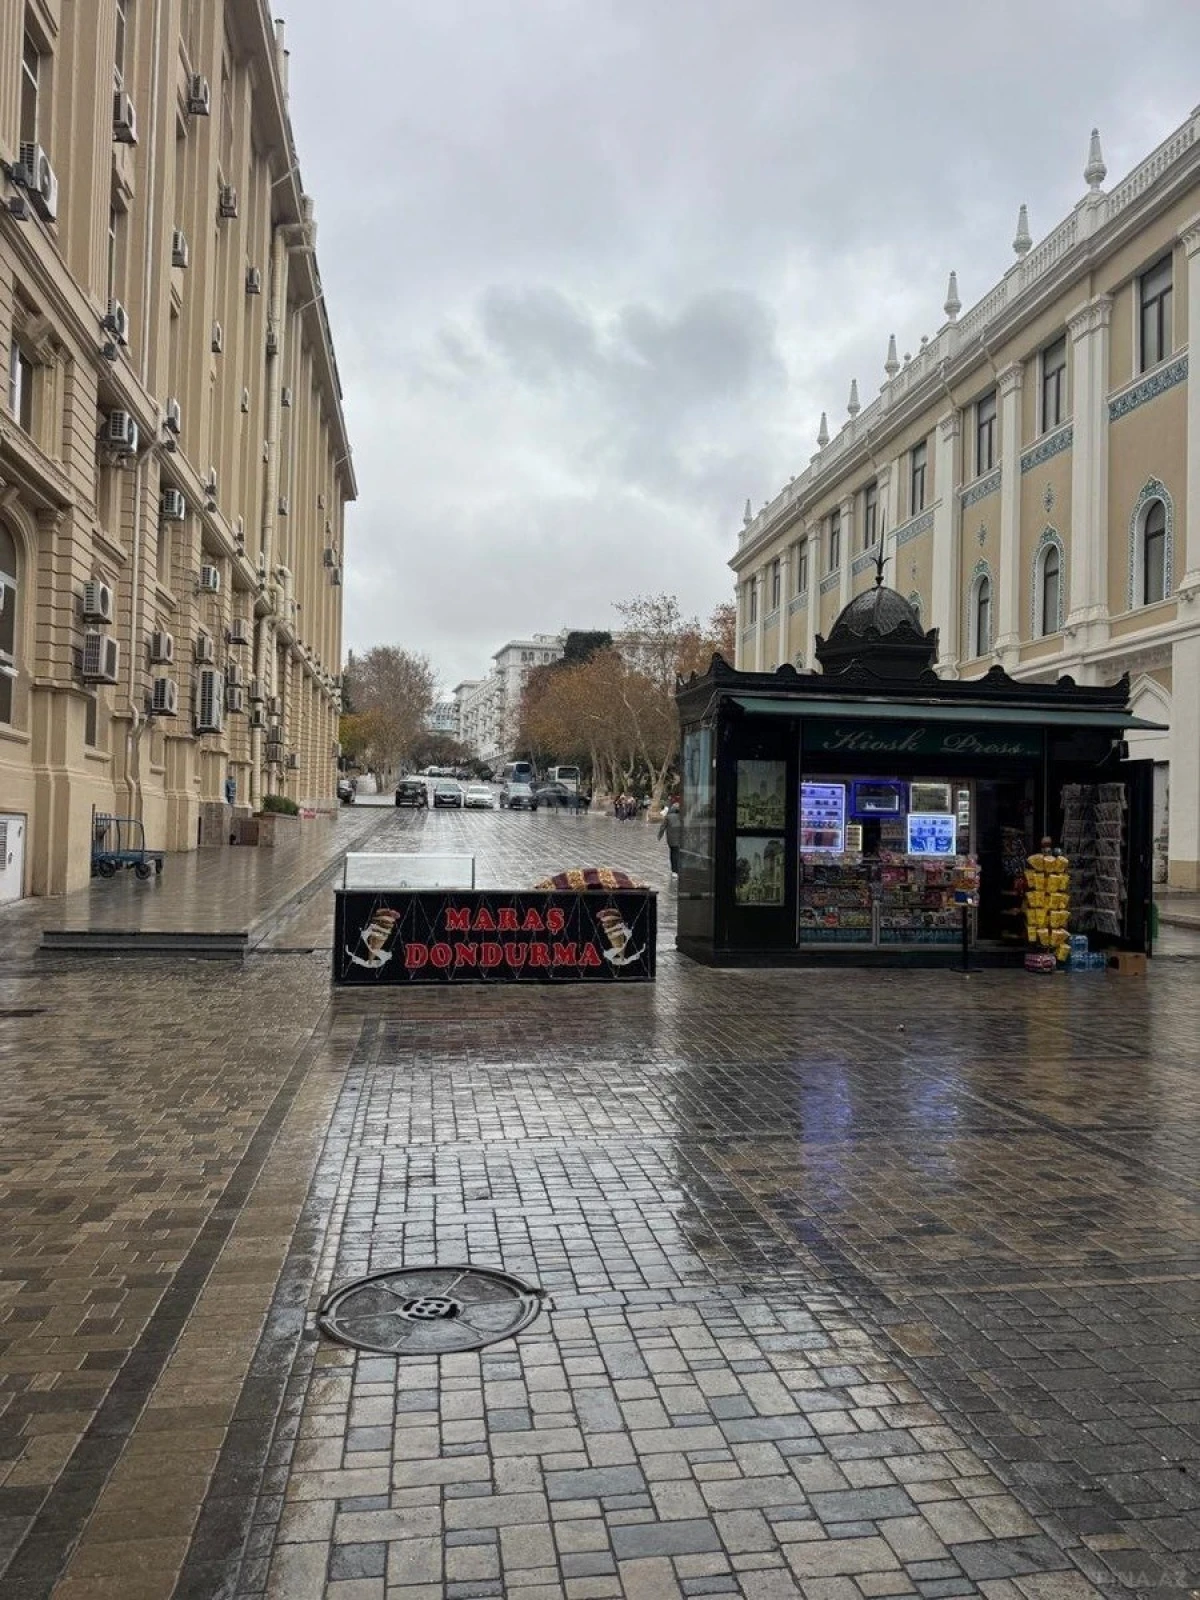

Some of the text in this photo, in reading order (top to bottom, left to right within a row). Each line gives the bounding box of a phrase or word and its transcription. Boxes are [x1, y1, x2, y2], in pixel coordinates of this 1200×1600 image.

[822, 727, 1025, 754] Kiosk Press
[445, 908, 565, 935] MARAŞ
[404, 943, 602, 968] DONDURMA
